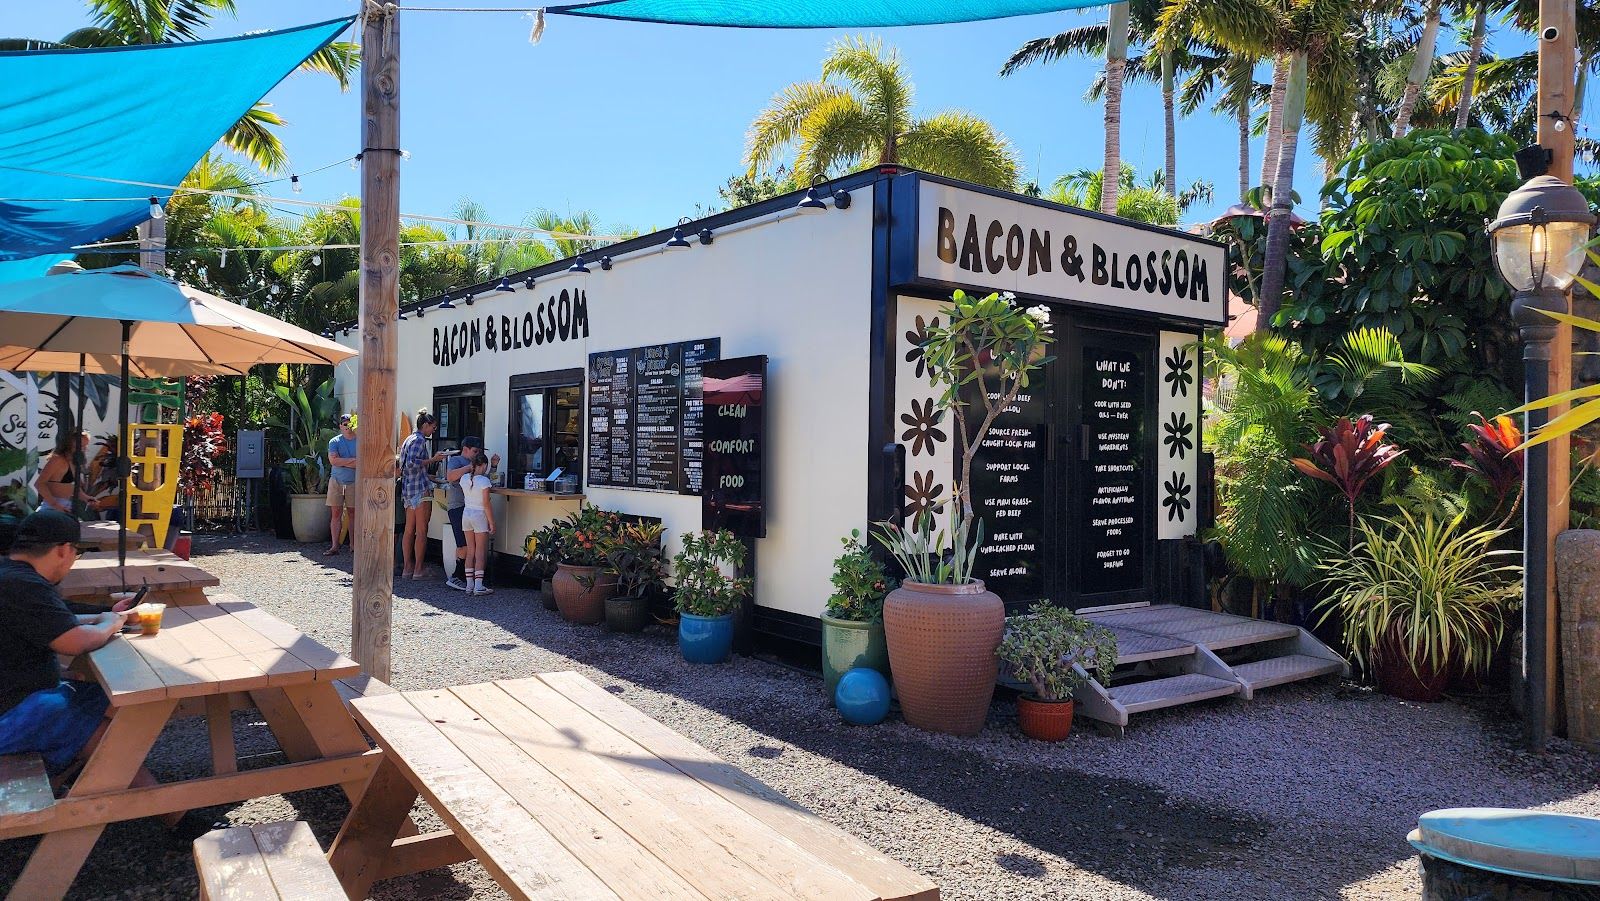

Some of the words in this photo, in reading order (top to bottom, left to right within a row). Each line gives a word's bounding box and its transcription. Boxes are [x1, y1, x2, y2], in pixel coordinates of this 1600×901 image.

[937, 207, 1051, 276] BACON
[1061, 234, 1085, 283] &
[1091, 243, 1210, 302] BLOSSOM
[433, 317, 480, 366] BACON
[485, 315, 498, 353] &
[502, 288, 589, 351] BLOSSOM
[1095, 360, 1117, 372] WHAT
[1119, 362, 1131, 373] WE
[1102, 378, 1127, 390] DON'T:
[1017, 394, 1031, 402] BEEF
[1107, 401, 1119, 409] WITH
[1120, 401, 1132, 409] SEED
[718, 403, 746, 418] CLEAN
[1098, 411, 1110, 419] OILS
[1116, 412, 1129, 420] EVER
[989, 427, 1010, 437] SOURCE
[1011, 428, 1031, 437] FRESH-
[1107, 433, 1130, 441] MYSTERY
[710, 439, 754, 454] COMFORT
[982, 439, 1004, 447] CAUGHT
[1005, 440, 1022, 448] LOCAL
[1023, 440, 1036, 448] FISH
[1098, 443, 1129, 452] INGREDIENTS
[986, 463, 1011, 471] SUPPORT
[1013, 463, 1030, 471] LOCAL
[1107, 464, 1134, 472] SHORTCUTS
[719, 474, 744, 489] FOOD
[1000, 475, 1018, 483] FARMS
[1098, 485, 1129, 494] ARTIFICIALLY
[985, 498, 996, 506] USE
[996, 498, 1011, 506] MAUI
[1011, 498, 1032, 506] GRASS-
[1092, 497, 1111, 505] FLAVOR
[1112, 496, 1135, 504] ANYTHING
[995, 509, 1006, 518] FED
[1007, 509, 1021, 518] BEEF
[1092, 518, 1107, 527] SERVE
[1108, 516, 1134, 525] PROCESSED
[993, 533, 1008, 541] BAKE
[1009, 532, 1023, 540] WITH
[1106, 528, 1122, 536] FOODS
[980, 544, 1016, 554] UNBLEACHED
[1017, 543, 1035, 552] FLOUR
[1096, 550, 1115, 559] FORGET
[1123, 548, 1130, 556] GO
[1103, 560, 1124, 569] SURFING
[990, 568, 1008, 577] SERVE
[1008, 567, 1026, 575] ALOHA
